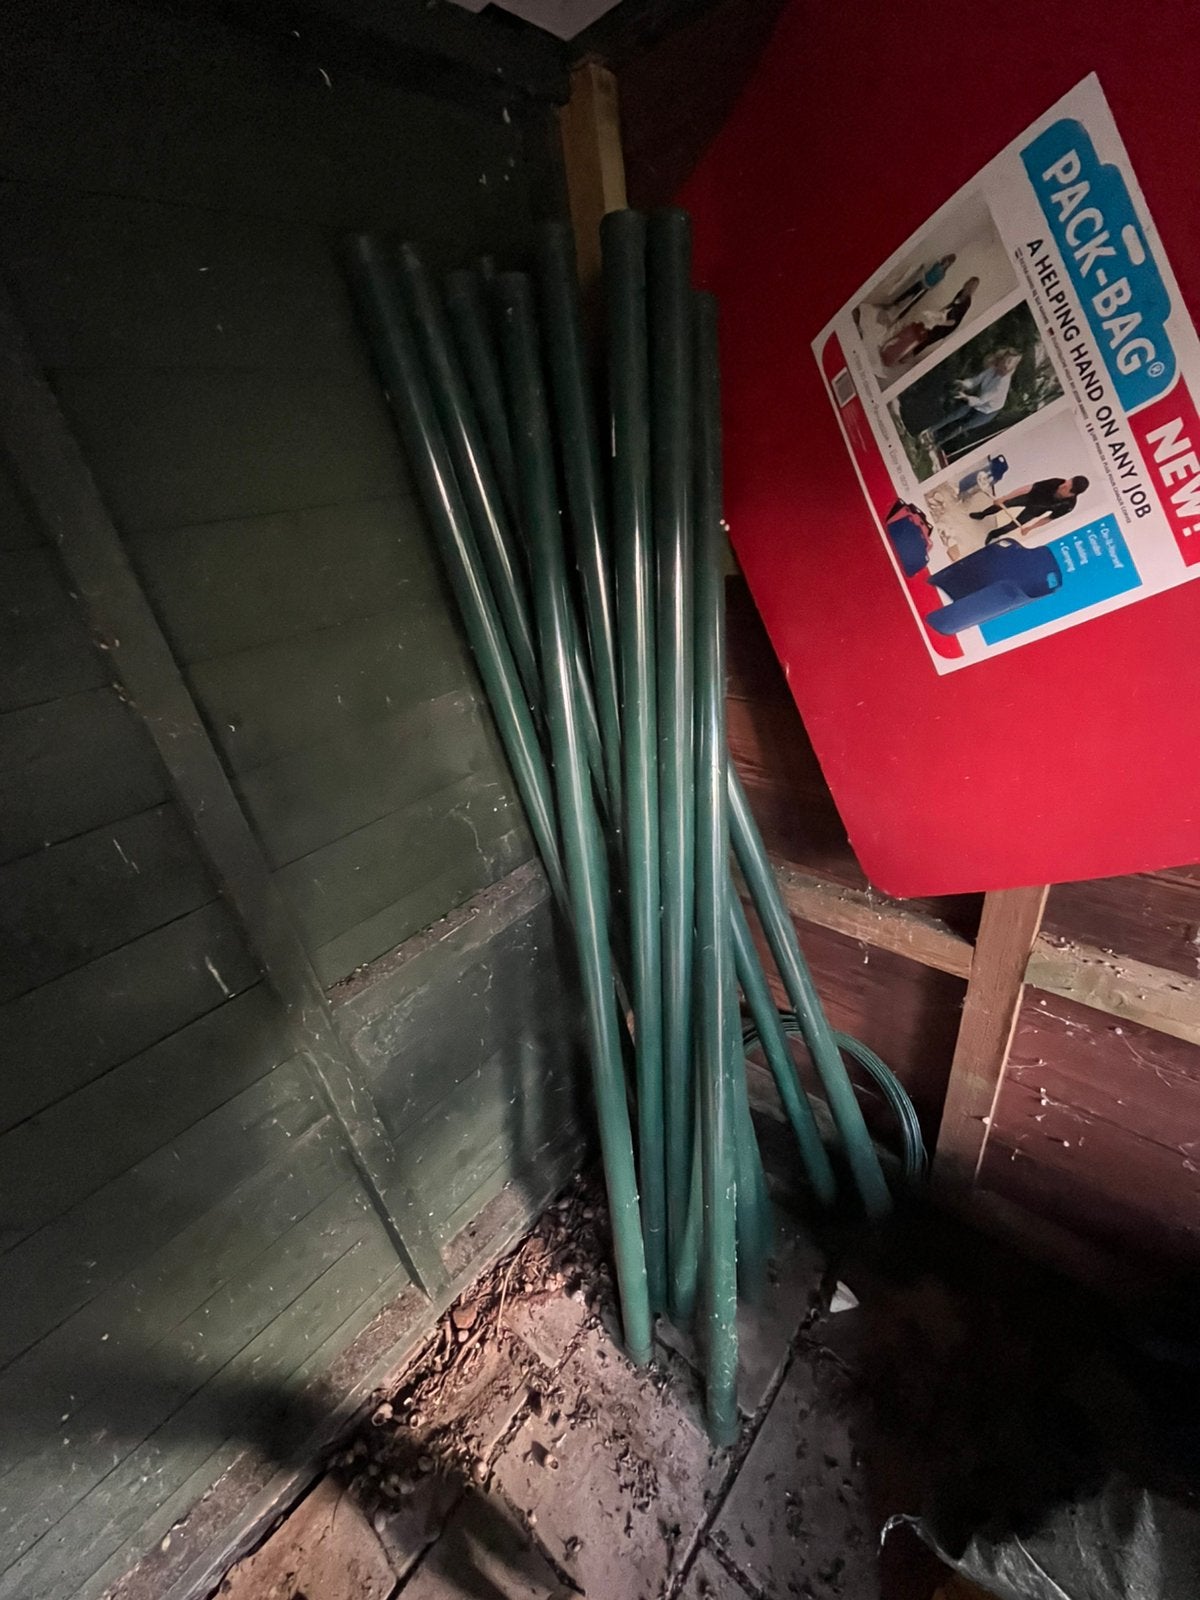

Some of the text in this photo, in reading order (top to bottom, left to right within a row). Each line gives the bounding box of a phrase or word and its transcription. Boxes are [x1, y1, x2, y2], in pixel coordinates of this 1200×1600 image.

[1026, 238, 1043, 257] A
[1034, 254, 1080, 342] HELPING
[1069, 342, 1104, 401] HAND
[1095, 405, 1120, 438] ON
[1108, 441, 1138, 479] ANY
[1122, 483, 1151, 518] JOB
